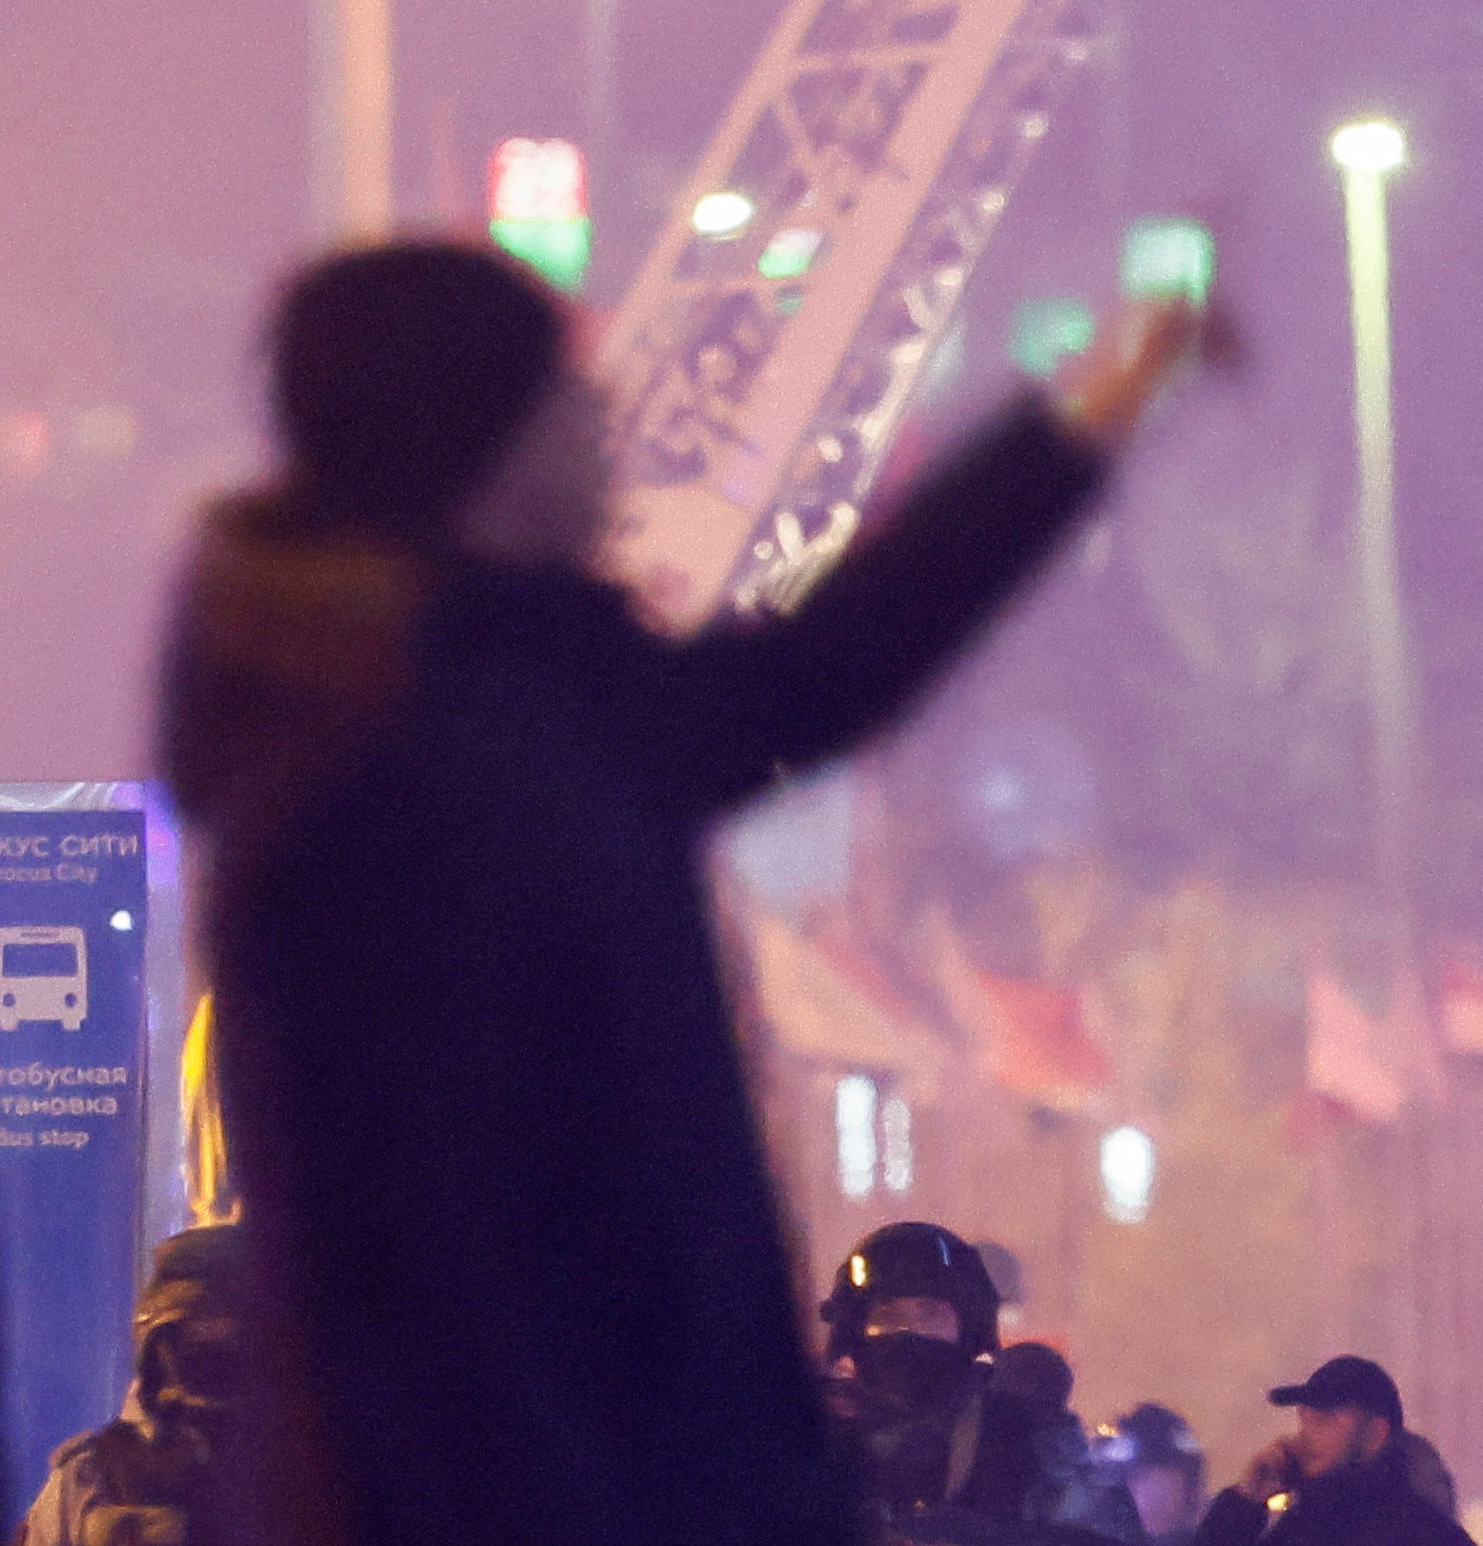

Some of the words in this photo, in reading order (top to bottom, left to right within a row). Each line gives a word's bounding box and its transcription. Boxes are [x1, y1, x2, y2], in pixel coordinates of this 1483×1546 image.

[60, 833, 139, 856] СИТИ
[56, 863, 99, 885] City
[39, 1129, 90, 1149] stop
